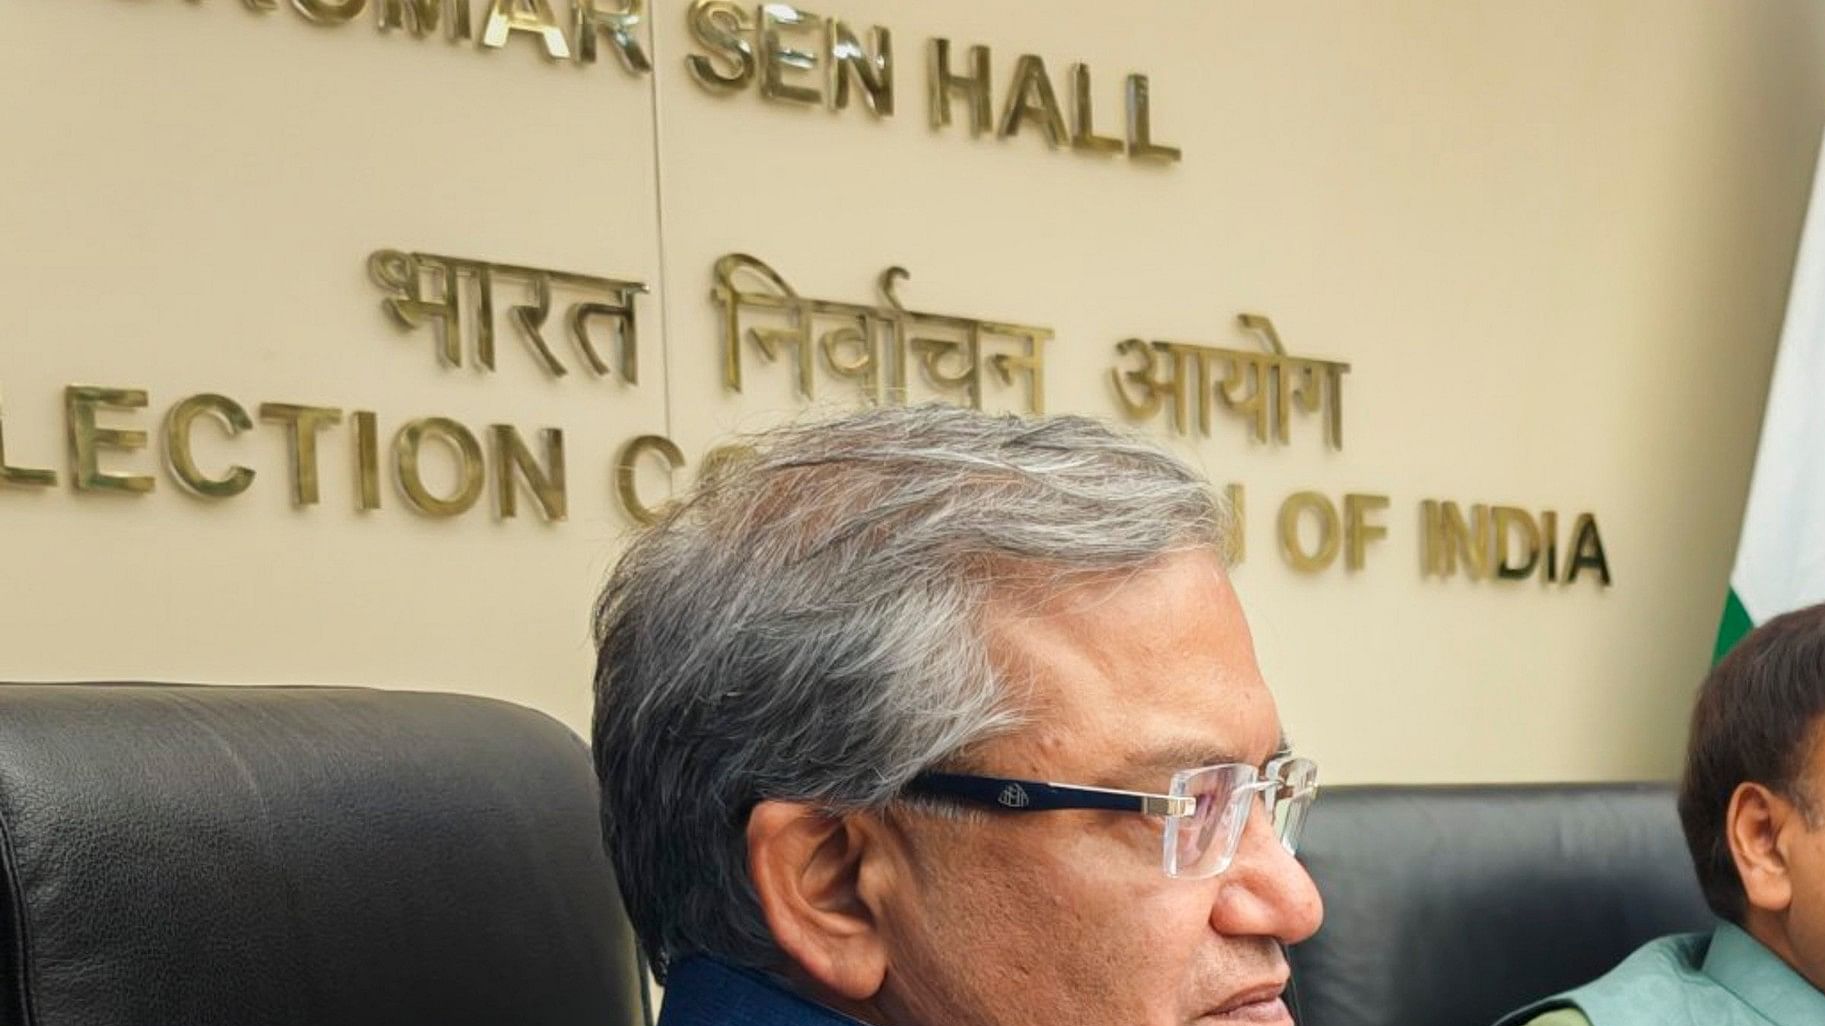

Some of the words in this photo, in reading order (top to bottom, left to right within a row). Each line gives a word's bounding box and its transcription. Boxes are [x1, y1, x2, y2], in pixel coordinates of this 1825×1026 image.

[685, 0, 894, 118] SEN
[927, 36, 1182, 163] HALL
[368, 248, 650, 388] भारत
[710, 250, 1056, 416] निर्वाचन
[1112, 312, 1351, 452] आयोग
[1276, 490, 1390, 575] OF
[1418, 499, 1612, 587] INDIA
